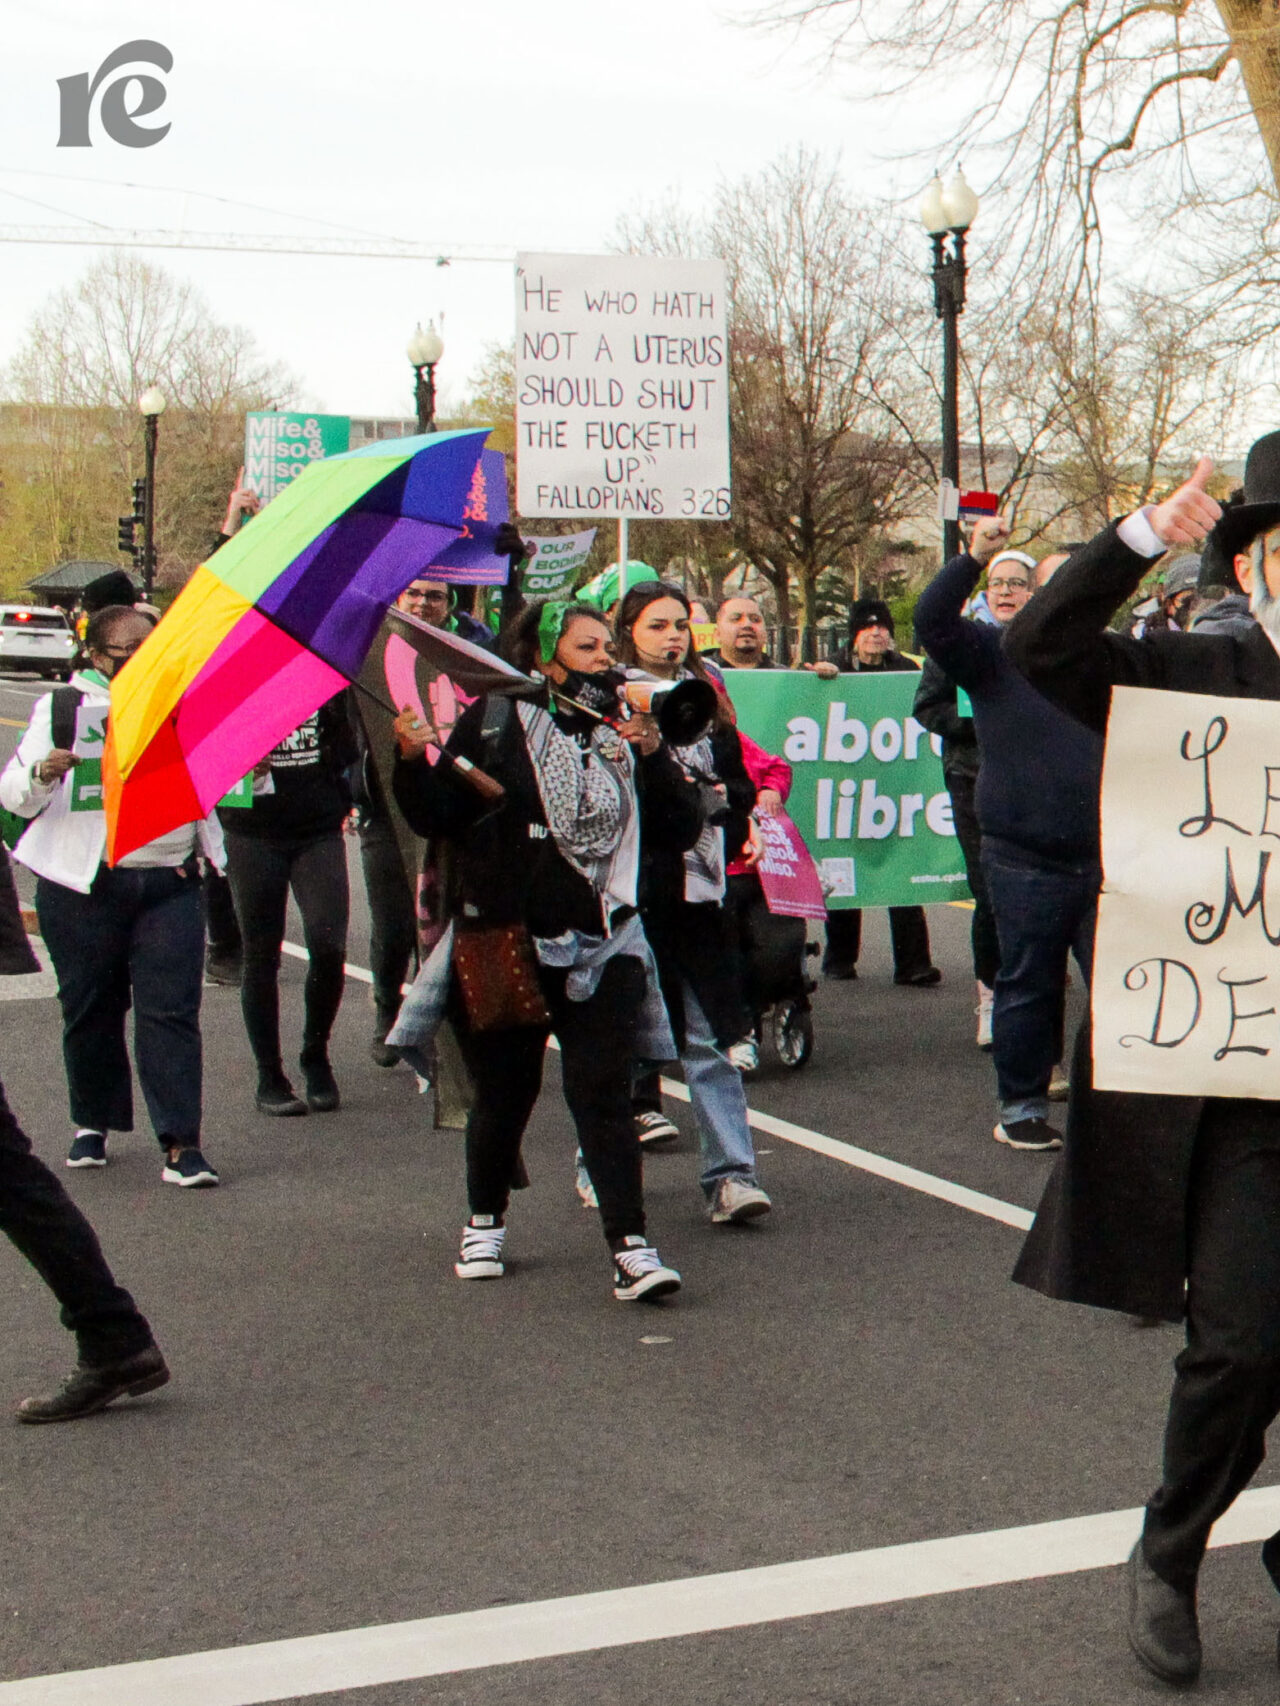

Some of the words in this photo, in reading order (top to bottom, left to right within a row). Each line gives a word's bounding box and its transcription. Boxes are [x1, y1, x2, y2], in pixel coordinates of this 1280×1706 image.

[584, 289, 638, 315] WHO
[652, 291, 714, 319] HATH
[523, 331, 579, 361] NOT
[594, 333, 613, 363] A
[632, 334, 723, 368] UTERUS
[519, 374, 624, 408] SHOULD
[637, 377, 716, 411] SHUT
[521, 420, 568, 449] THE
[585, 420, 697, 452] FUCKETH
[536, 484, 664, 515] FALLOPIANS
[541, 541, 575, 554] OUR
[815, 777, 957, 840] libre
